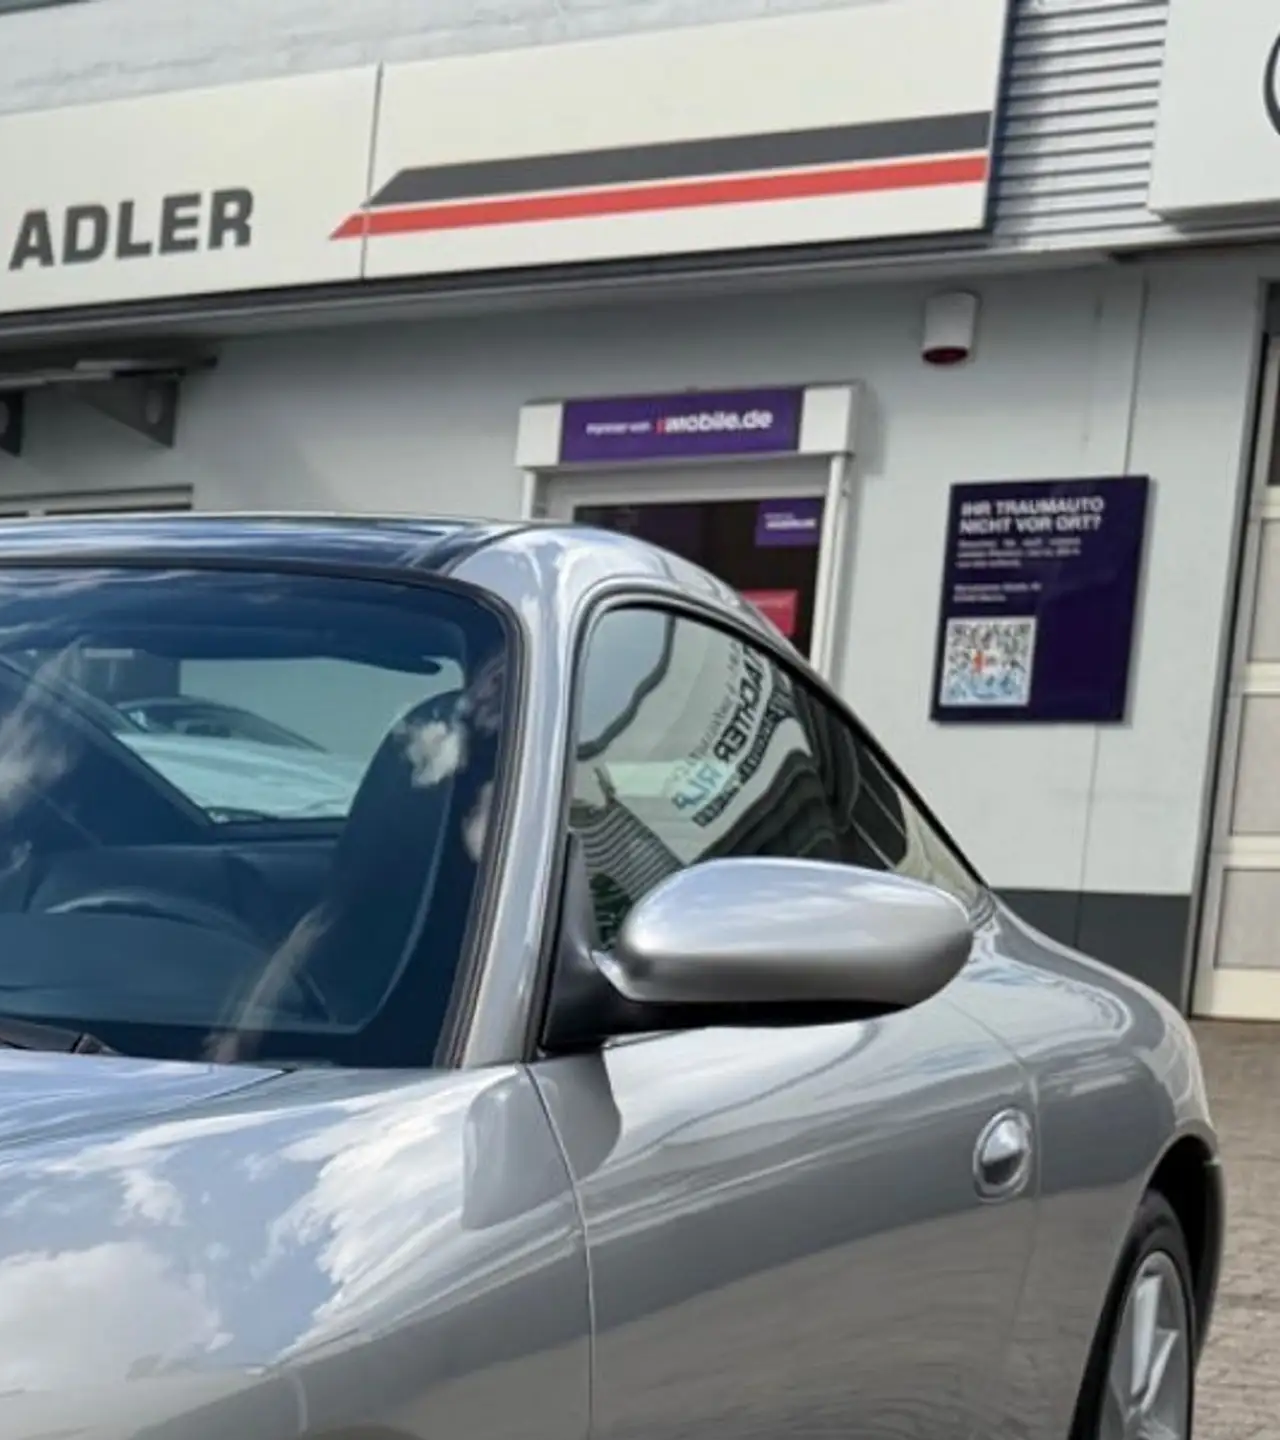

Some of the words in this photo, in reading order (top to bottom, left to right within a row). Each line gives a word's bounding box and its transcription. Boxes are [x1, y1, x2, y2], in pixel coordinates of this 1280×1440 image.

[8, 187, 254, 271] ADLER
[656, 409, 773, 434] mobile.de
[996, 495, 1105, 515] TRAUMAUTO
[959, 517, 1012, 535] NICHT
[1015, 515, 1053, 532] VOR
